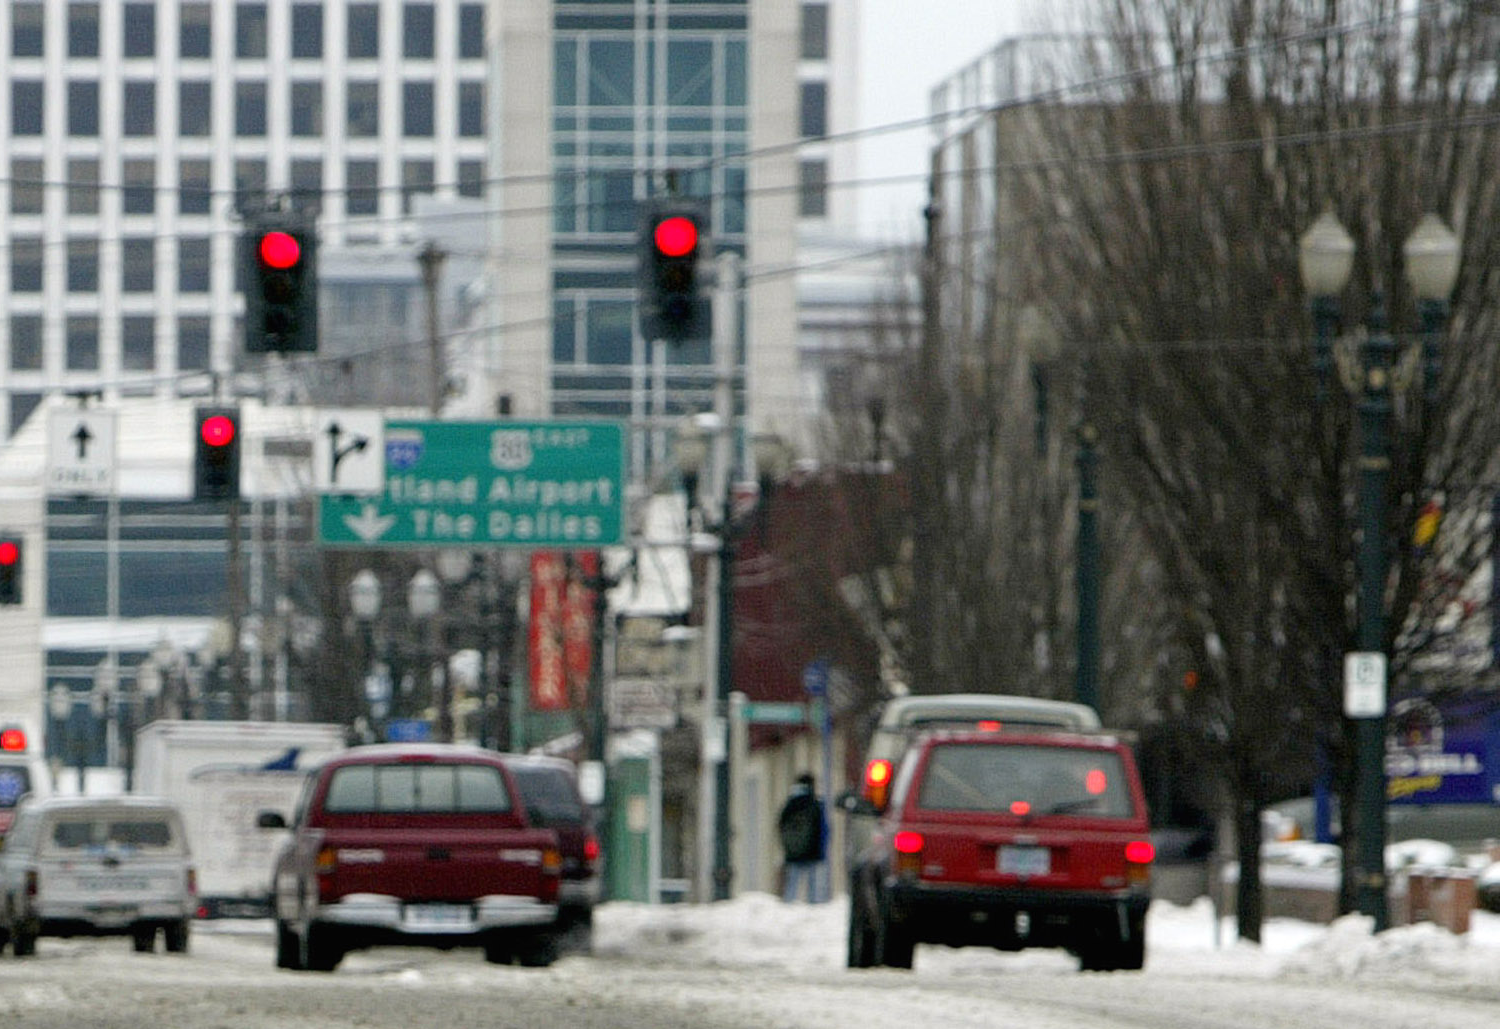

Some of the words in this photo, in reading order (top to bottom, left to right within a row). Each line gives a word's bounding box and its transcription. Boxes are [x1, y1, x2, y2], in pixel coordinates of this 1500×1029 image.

[488, 474, 612, 506] Airport
[412, 508, 477, 537] The
[488, 508, 602, 540] Dalles
